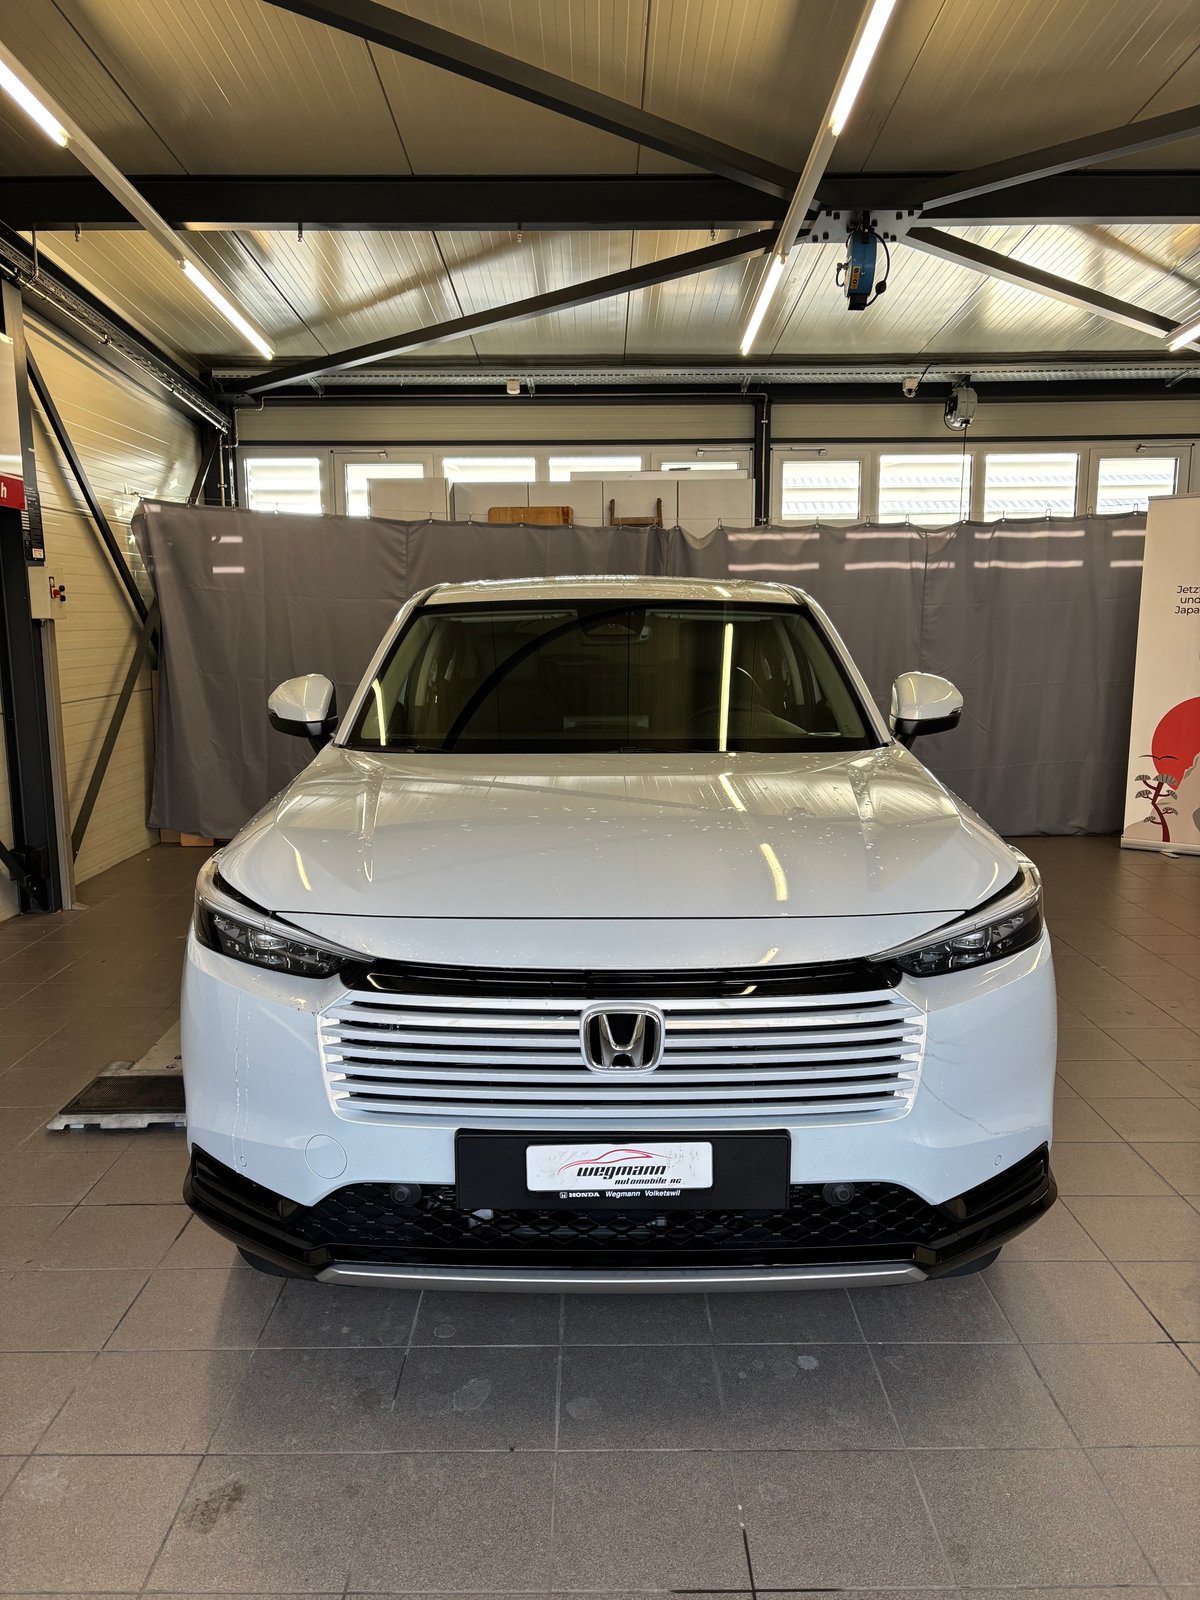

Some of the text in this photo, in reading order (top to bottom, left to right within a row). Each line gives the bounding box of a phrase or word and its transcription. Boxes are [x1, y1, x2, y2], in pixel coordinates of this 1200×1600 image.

[1176, 585, 1200, 594] Jetz
[577, 1165, 667, 1180] wegmann
[614, 1177, 667, 1185] automobile
[605, 1190, 641, 1199] Wegmann
[644, 1189, 681, 1197] Volketswil
